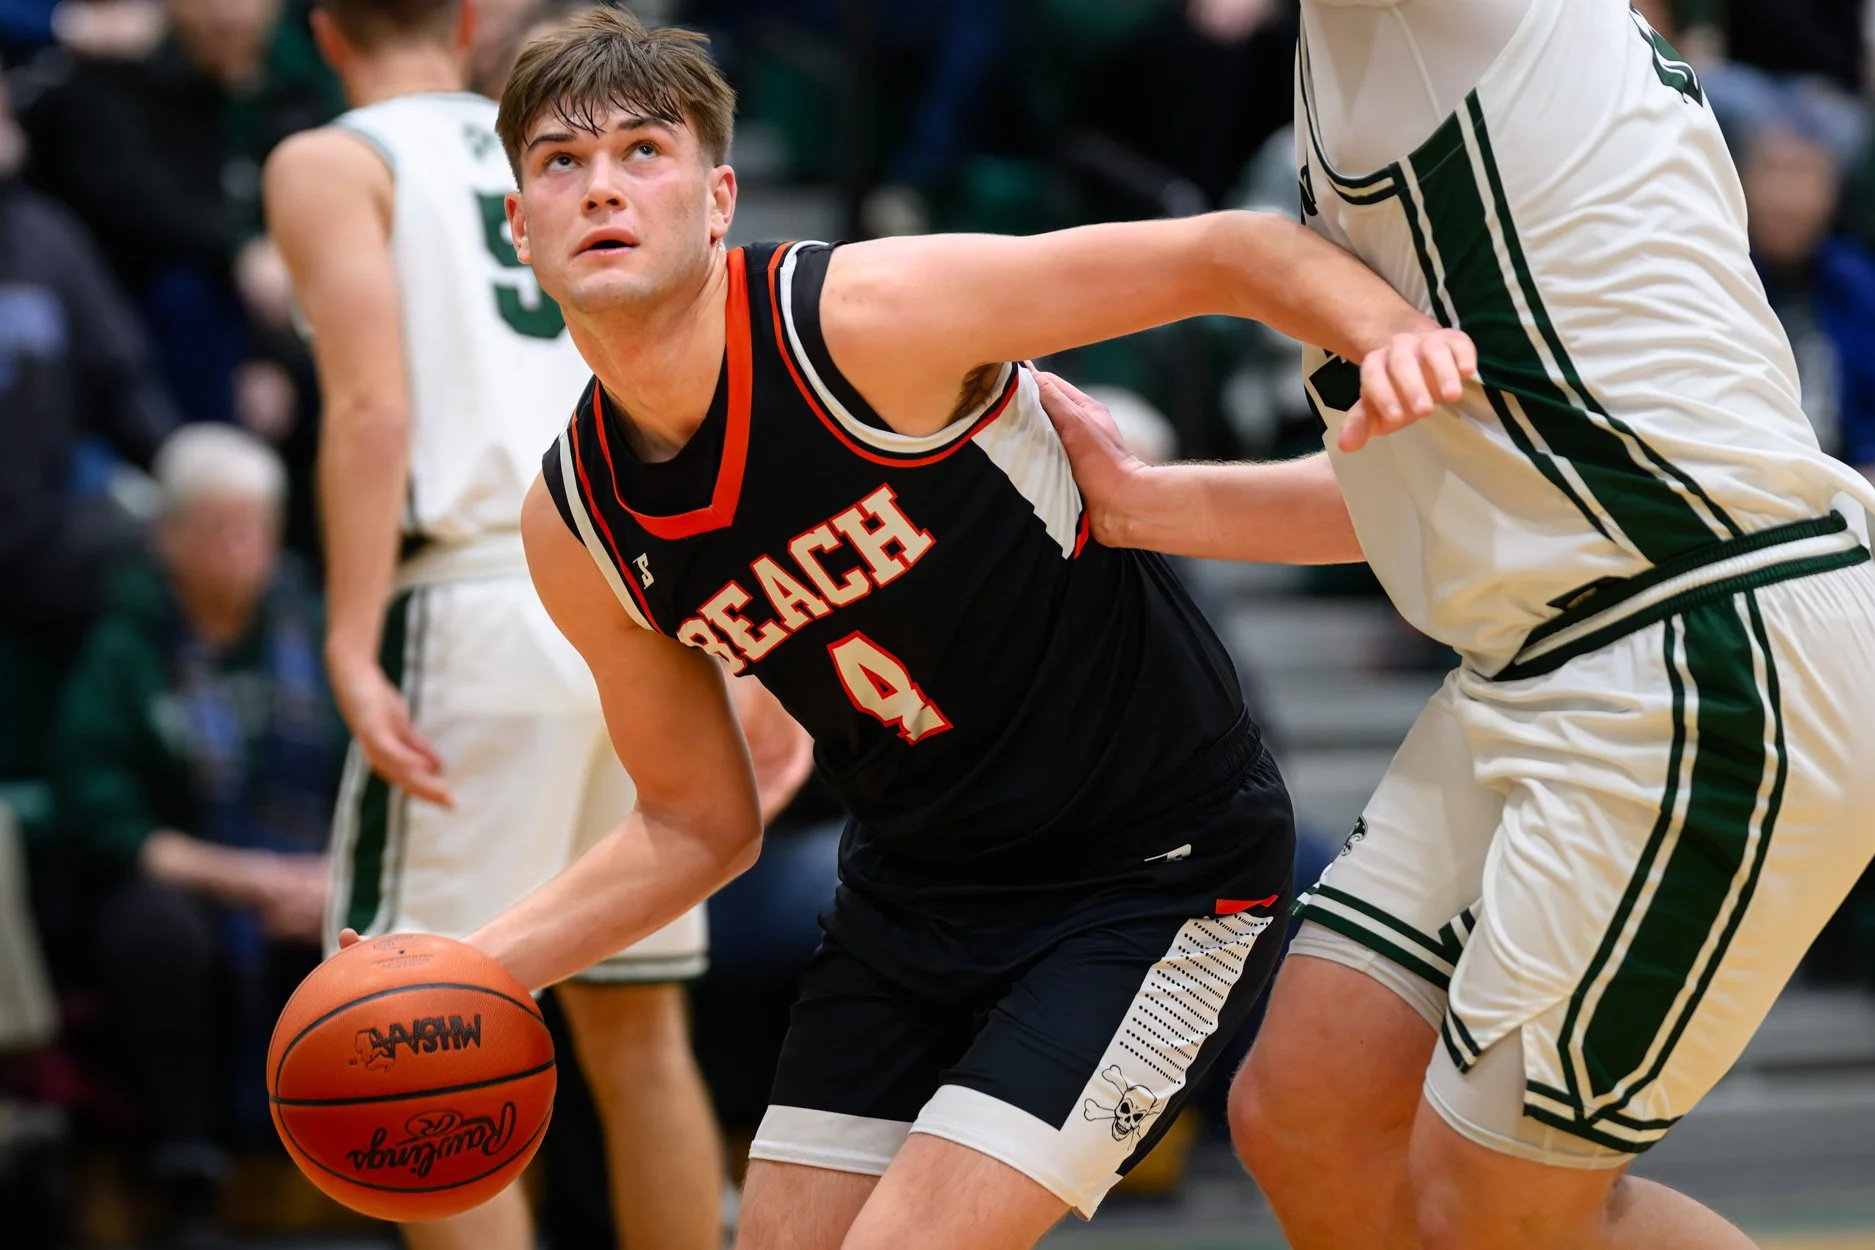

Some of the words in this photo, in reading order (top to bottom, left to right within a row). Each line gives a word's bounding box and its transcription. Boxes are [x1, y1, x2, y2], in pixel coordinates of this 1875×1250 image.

[676, 482, 937, 677] BEACH
[827, 630, 954, 746] 4
[346, 1101, 517, 1178] Rawlings
